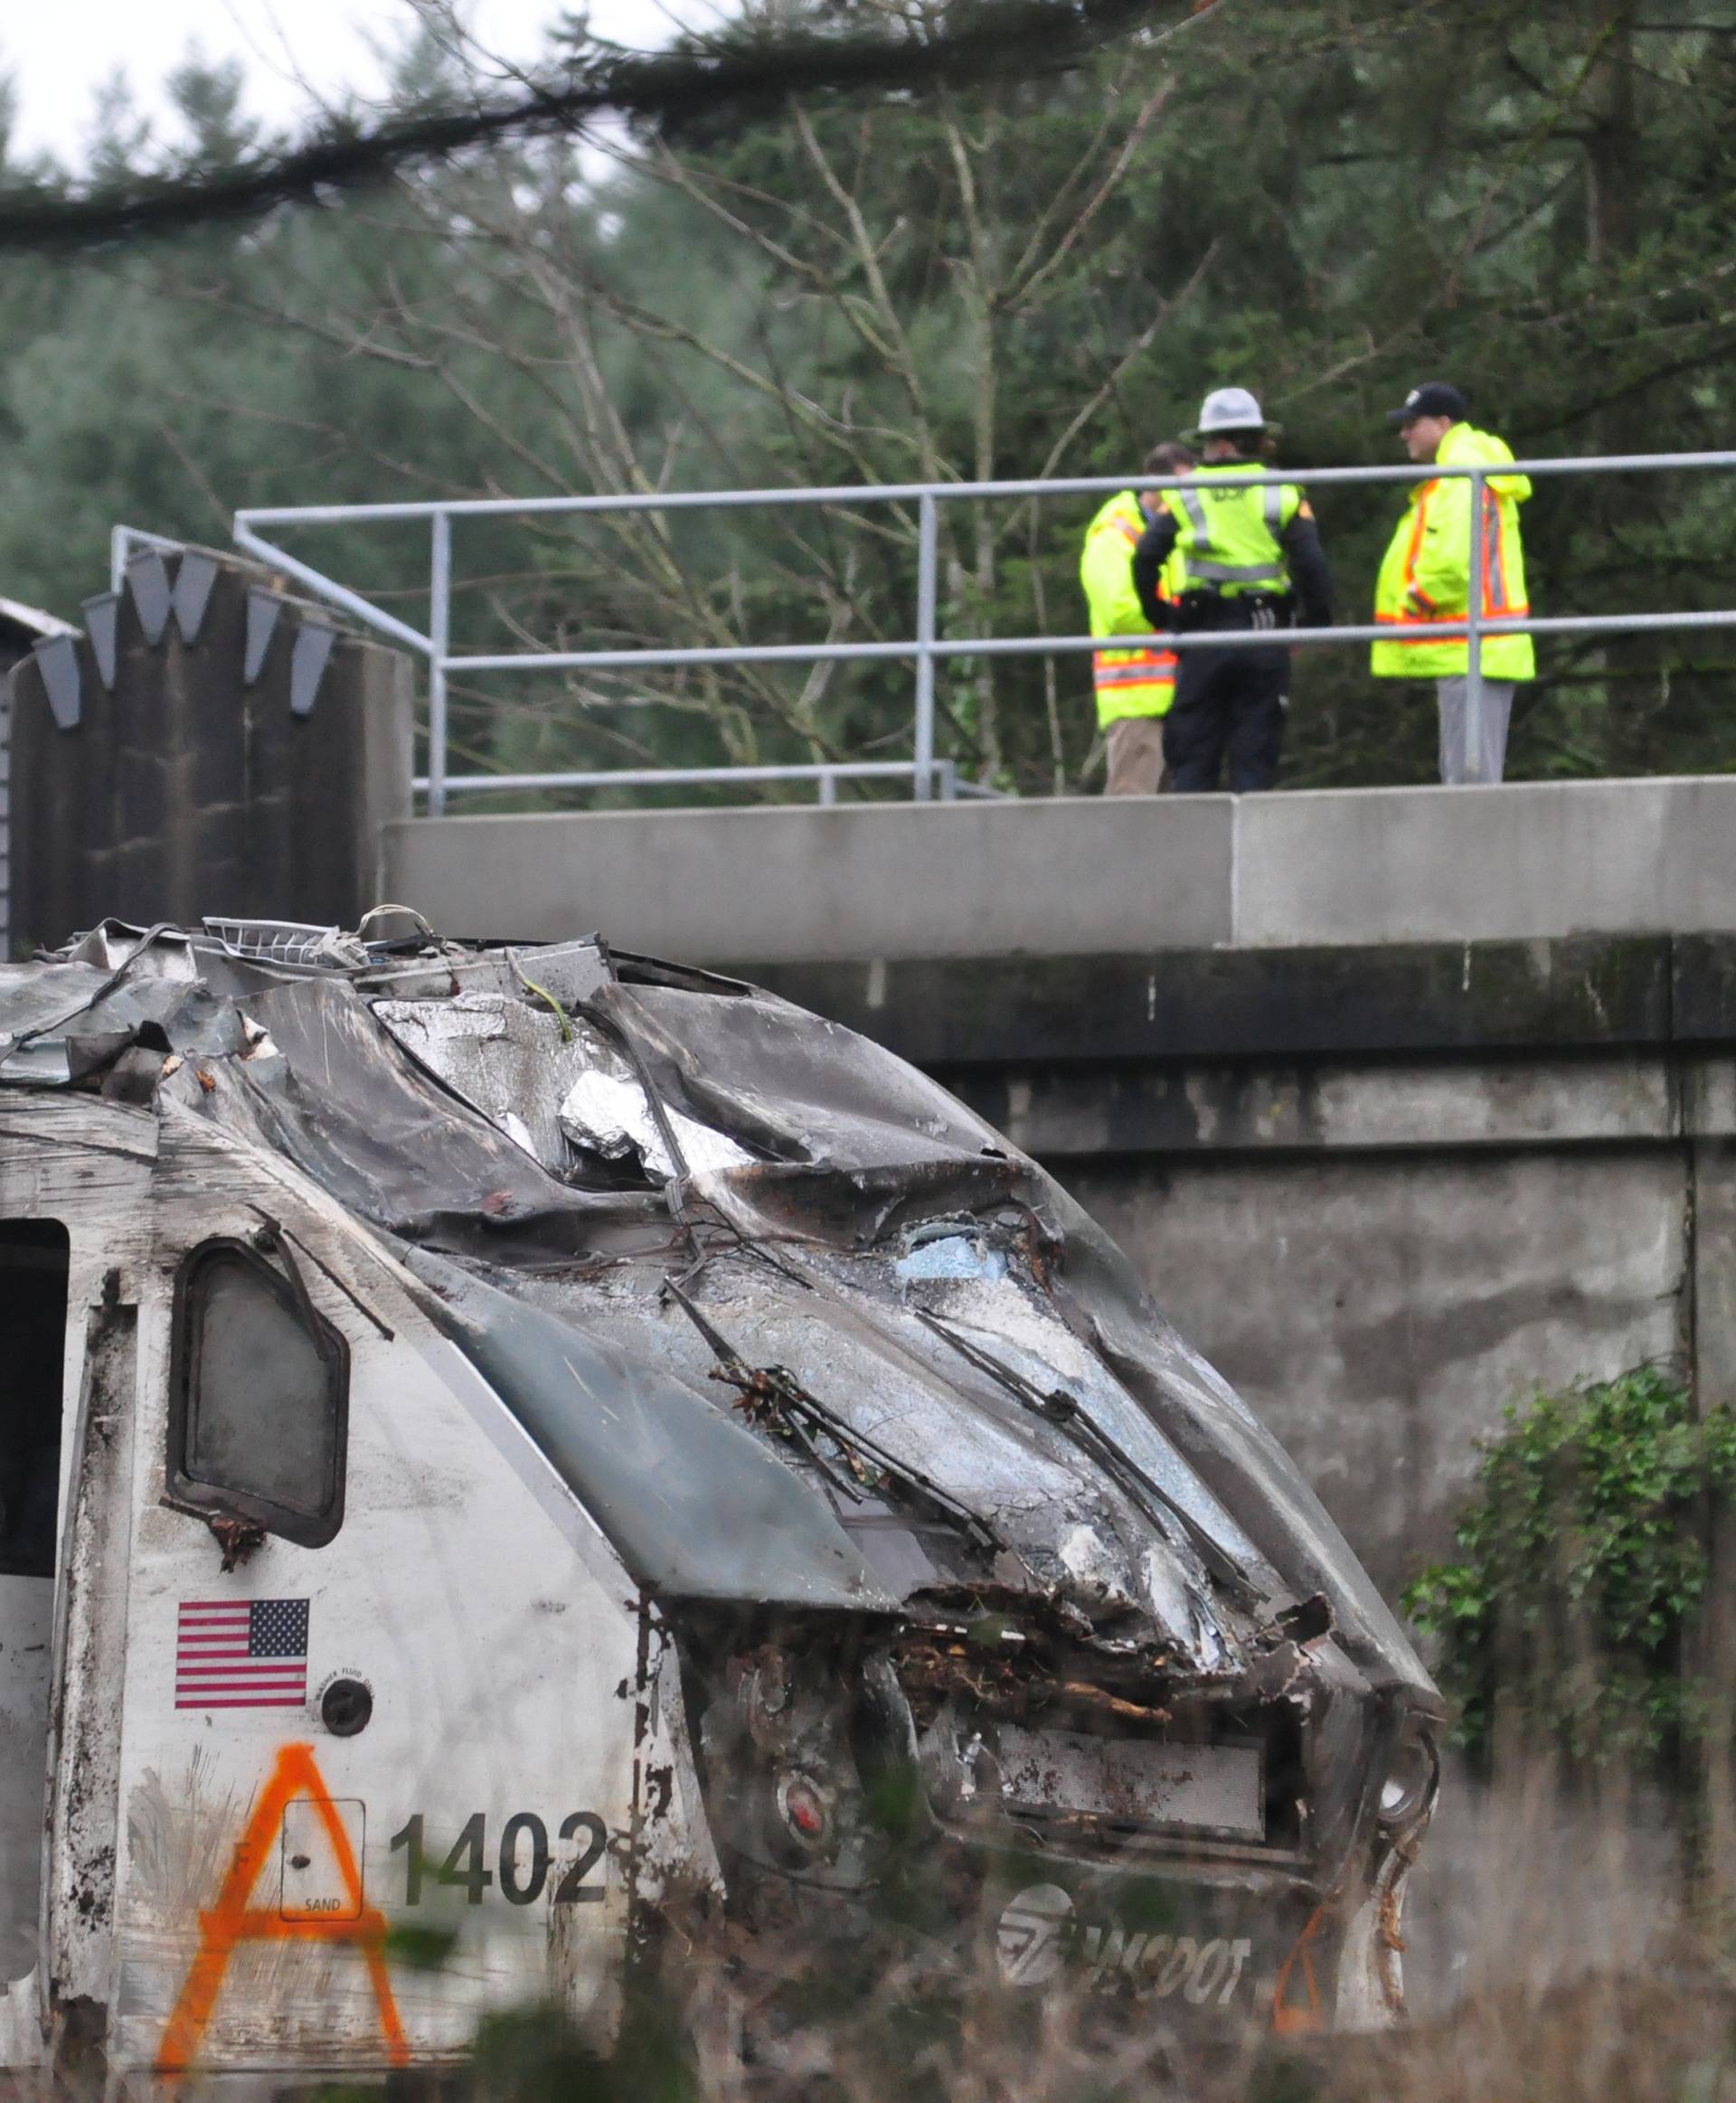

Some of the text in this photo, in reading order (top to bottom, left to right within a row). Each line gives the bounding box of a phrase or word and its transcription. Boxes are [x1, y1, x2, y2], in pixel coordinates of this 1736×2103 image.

[315, 1671, 337, 1701] WASHER
[342, 1667, 363, 1678] FLUID
[390, 1811, 608, 1906] 1402
[152, 1741, 411, 2084] A
[304, 1898, 341, 1912] SAND
